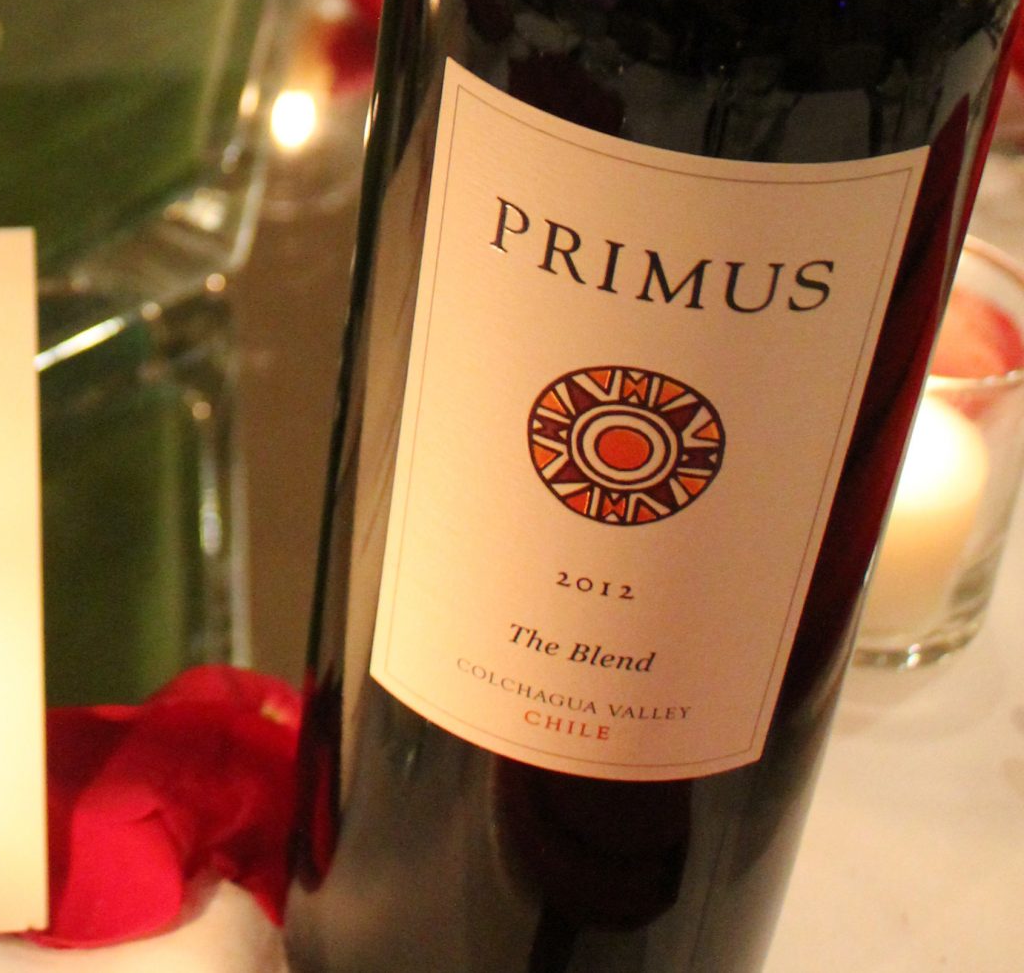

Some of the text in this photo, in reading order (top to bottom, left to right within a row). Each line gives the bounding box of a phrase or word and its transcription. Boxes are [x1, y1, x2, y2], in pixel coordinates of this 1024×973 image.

[489, 196, 835, 314] PRIMUS
[556, 571, 635, 600] 2012
[508, 623, 657, 673] The Blend
[456, 657, 692, 720] COLCHAGUA VALLEY
[523, 709, 611, 741] CHILE
